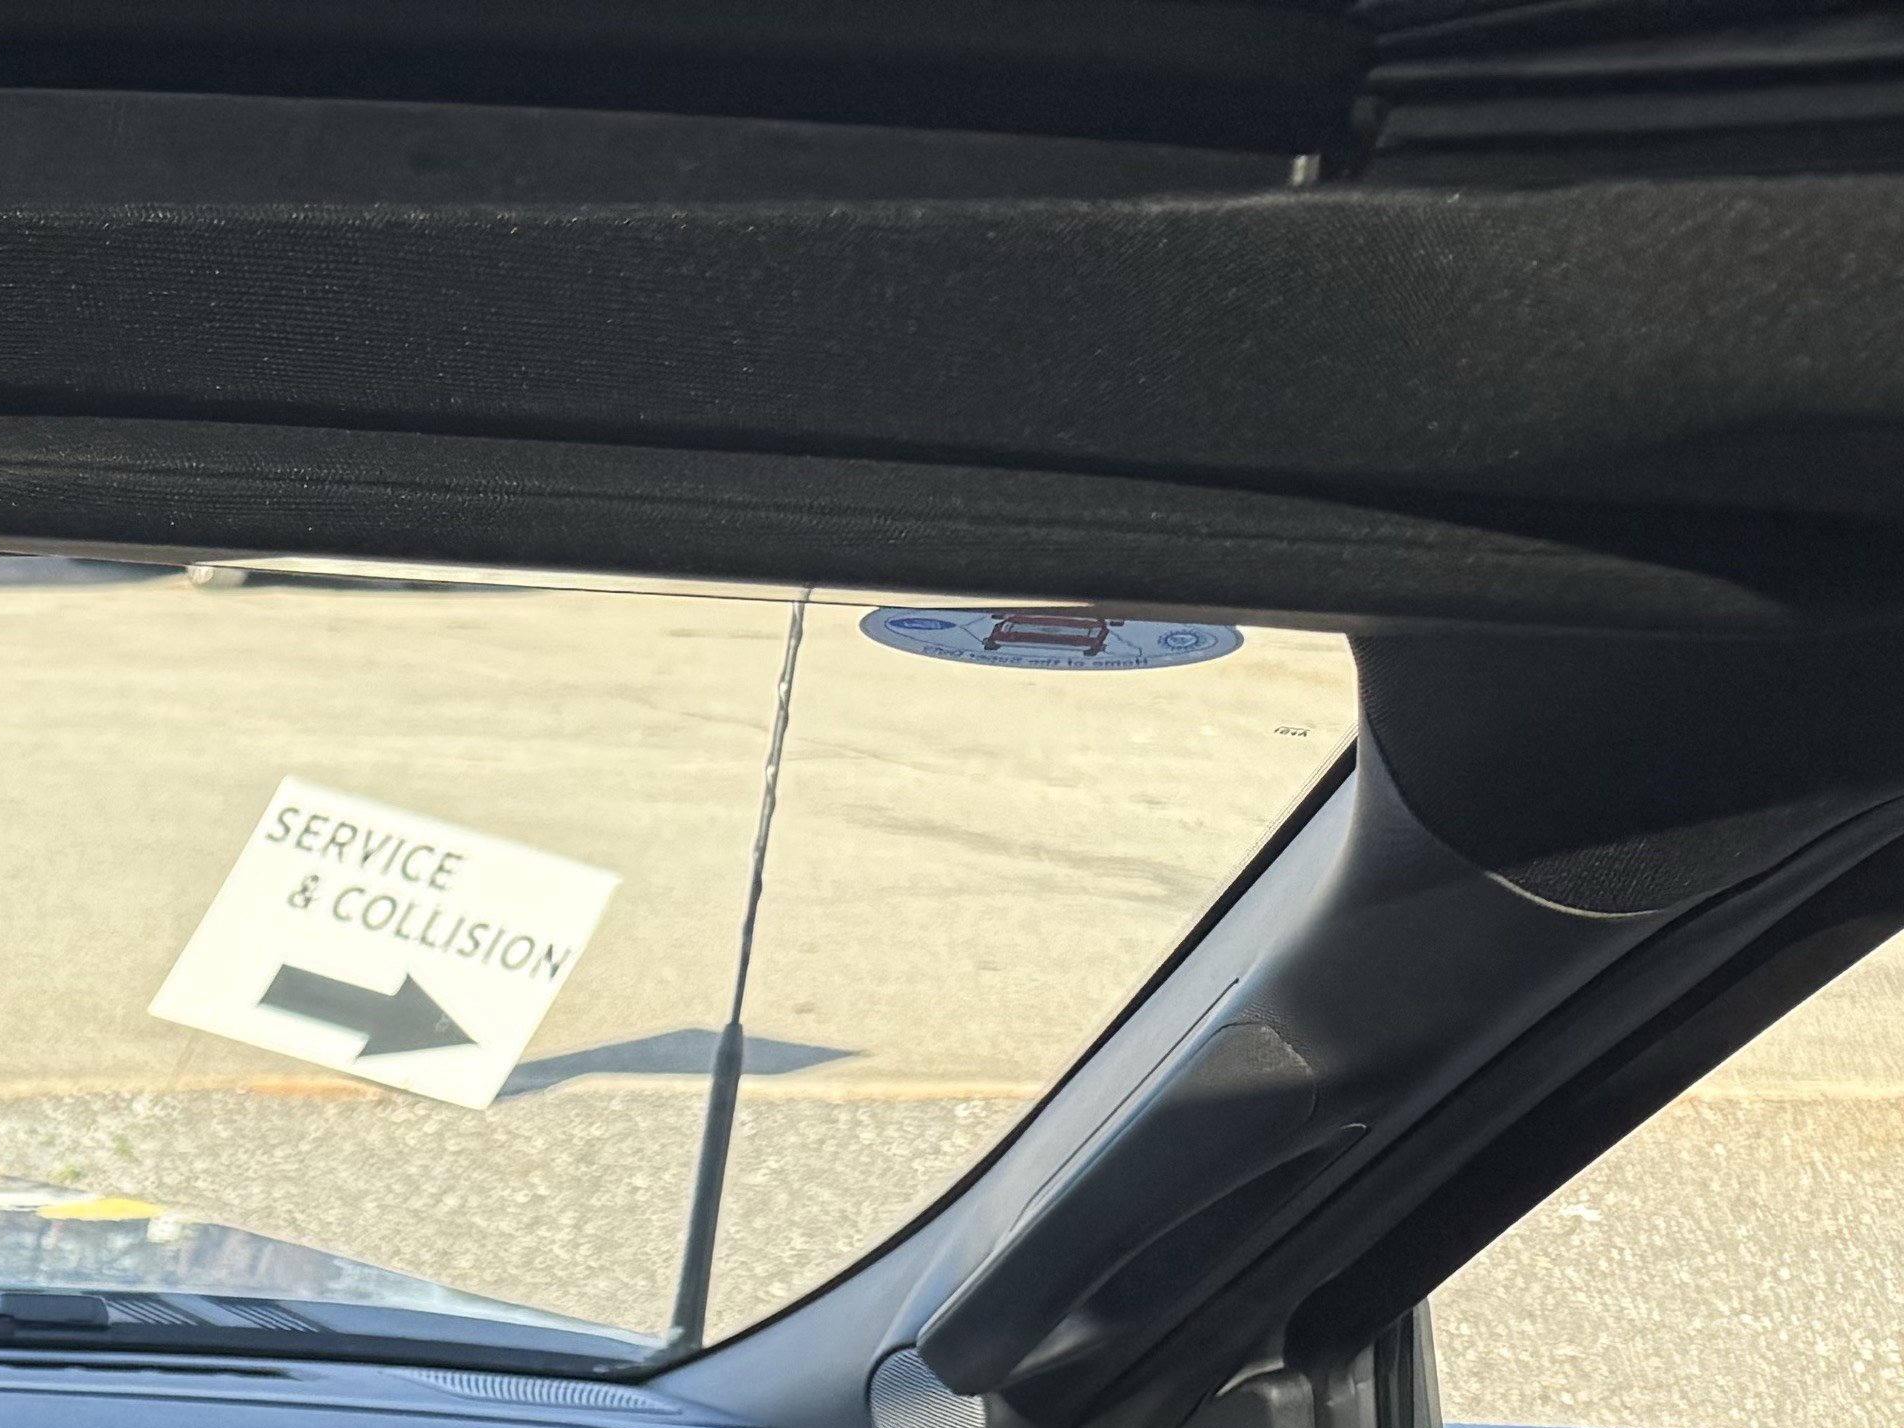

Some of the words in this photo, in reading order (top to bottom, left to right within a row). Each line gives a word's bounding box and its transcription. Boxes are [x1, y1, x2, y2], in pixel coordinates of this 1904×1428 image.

[265, 806, 467, 892] SERVICE
[287, 874, 321, 910] &
[332, 885, 574, 982] COLLISION
